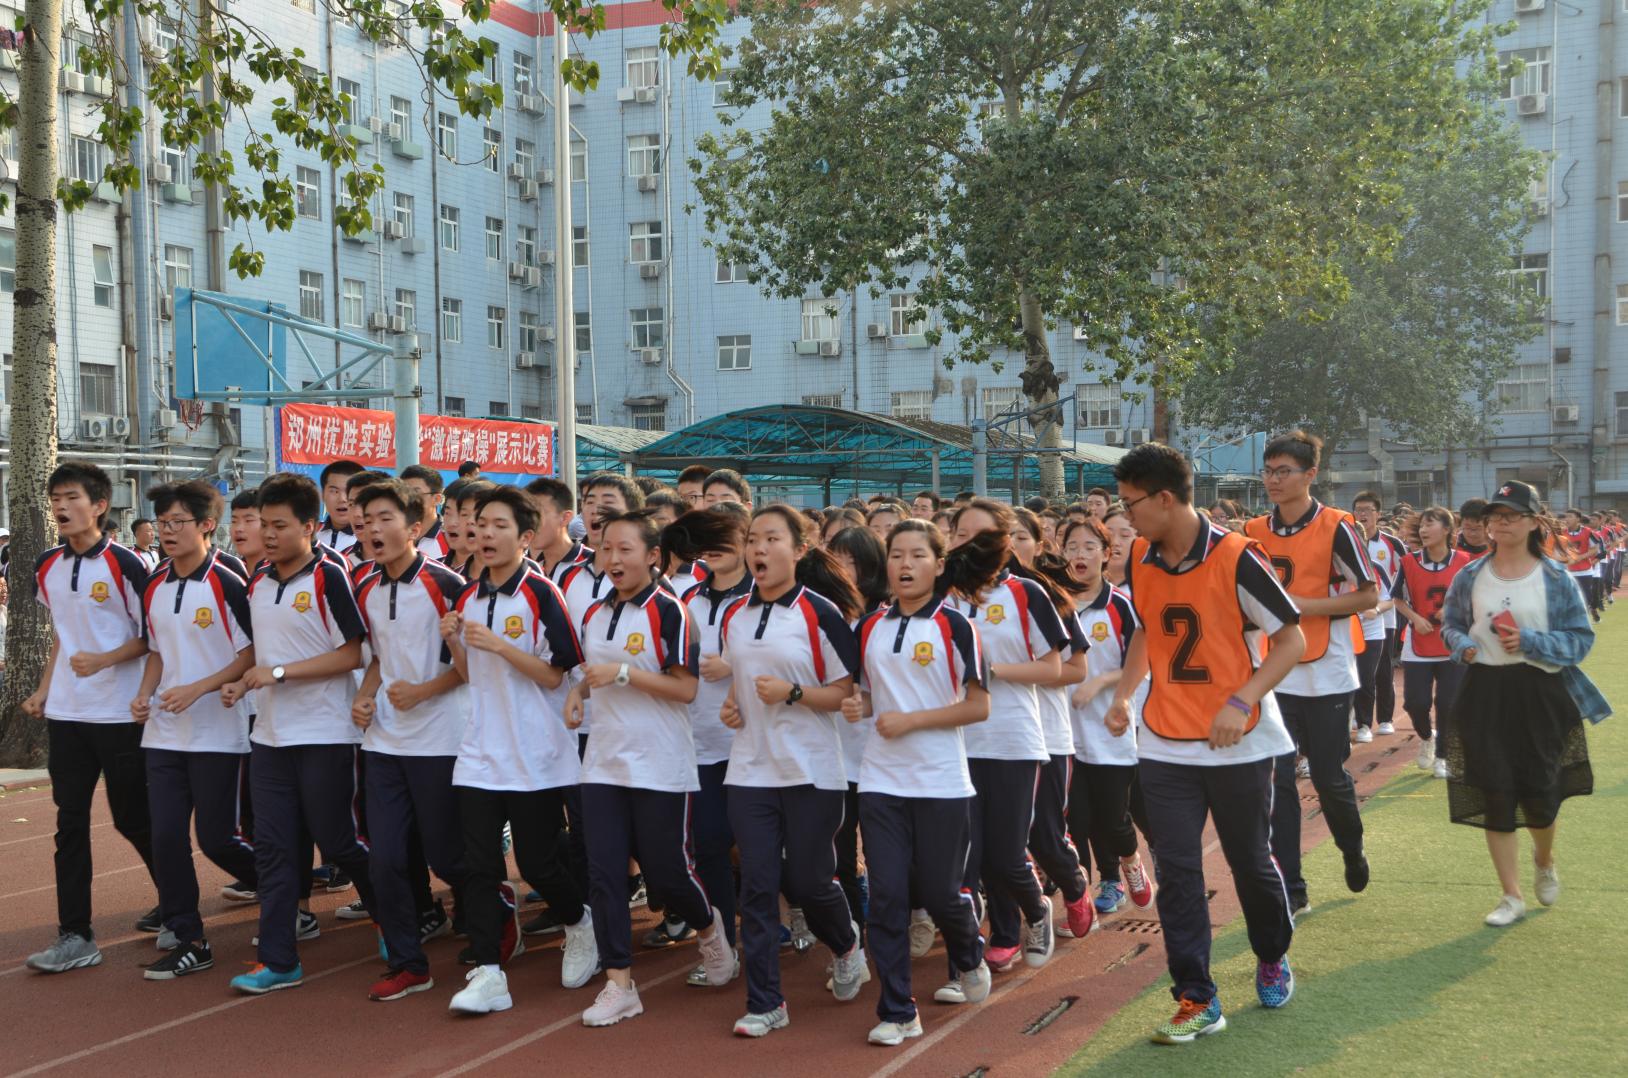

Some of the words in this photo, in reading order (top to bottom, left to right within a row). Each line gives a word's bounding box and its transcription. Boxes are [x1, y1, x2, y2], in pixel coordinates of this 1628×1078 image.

[287, 413, 549, 468] 郑州优胜实验“激情跑操”展示比赛
[1160, 603, 1213, 684] 2
